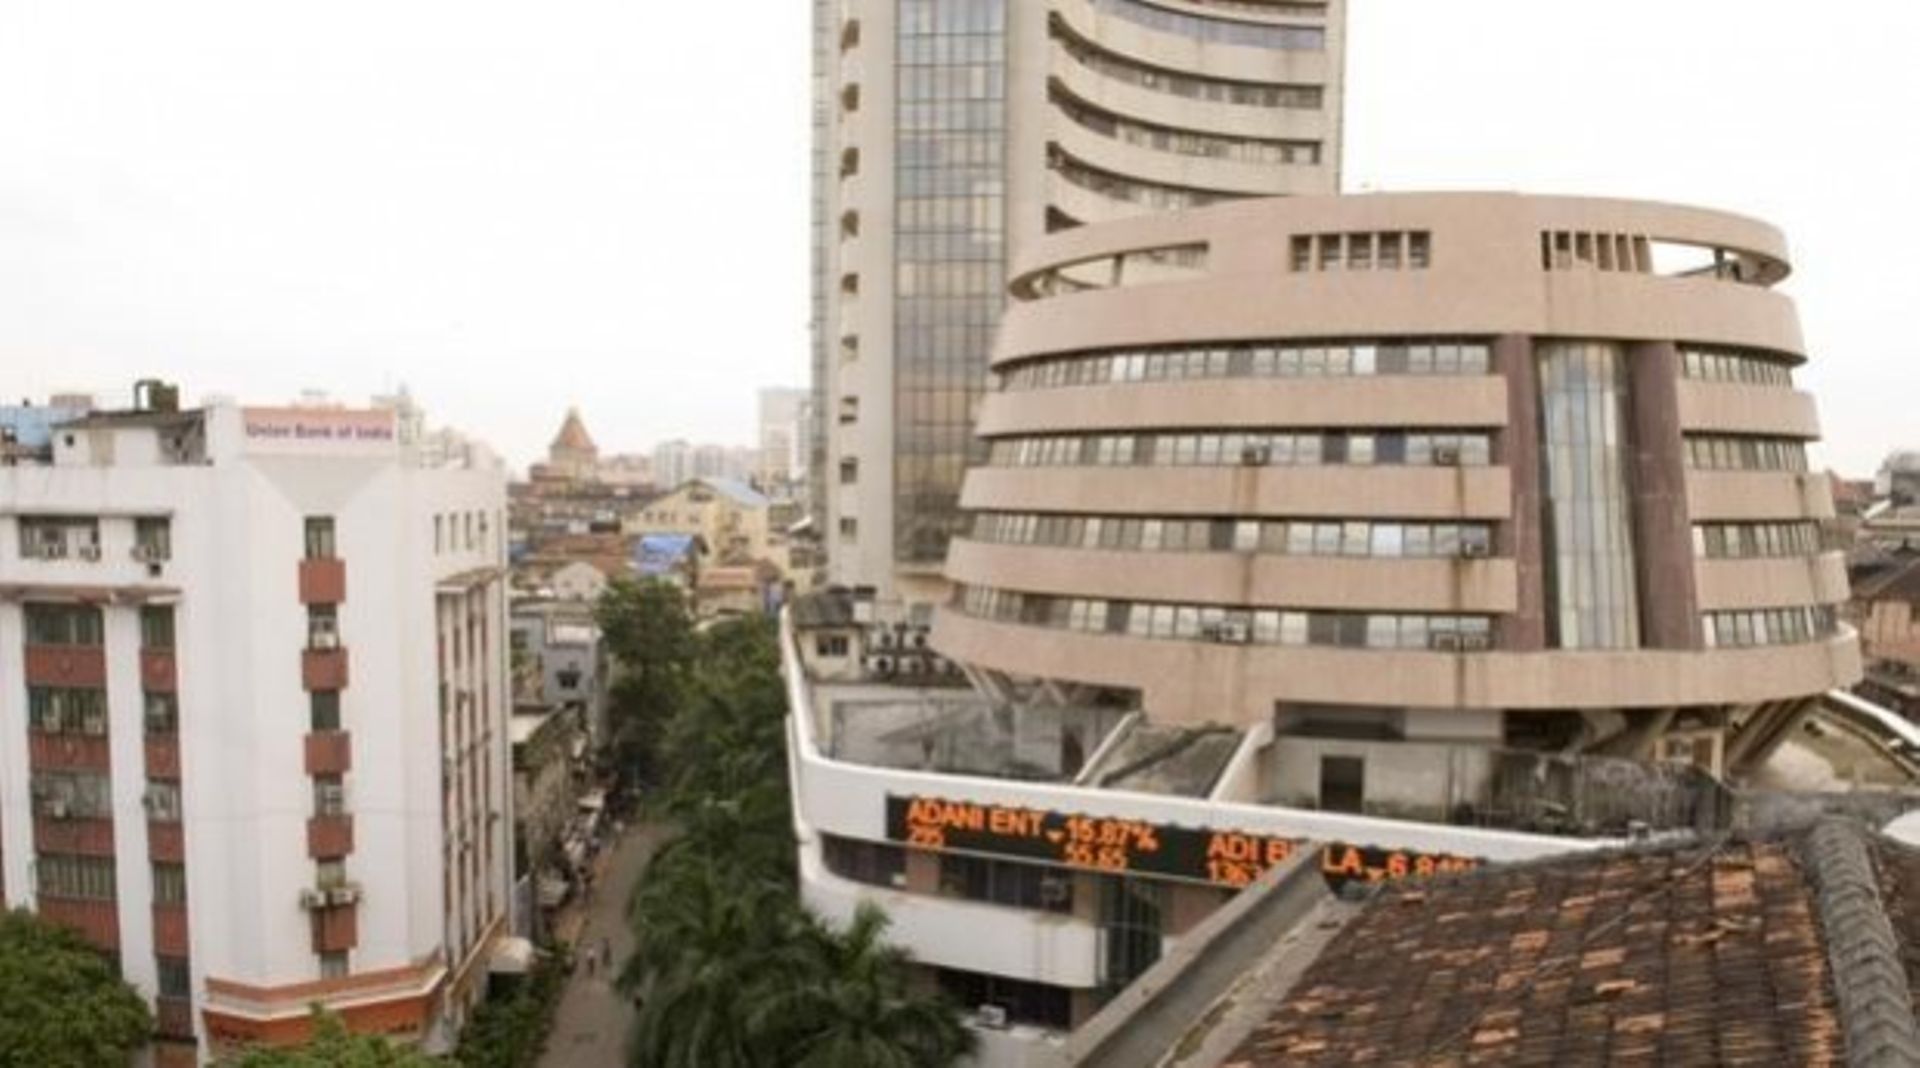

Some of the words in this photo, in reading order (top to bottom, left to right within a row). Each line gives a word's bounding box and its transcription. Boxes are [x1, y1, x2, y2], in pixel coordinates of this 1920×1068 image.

[907, 799, 984, 831] ADANI
[989, 808, 1041, 838] ENT
[1208, 834, 1259, 862] ADI
